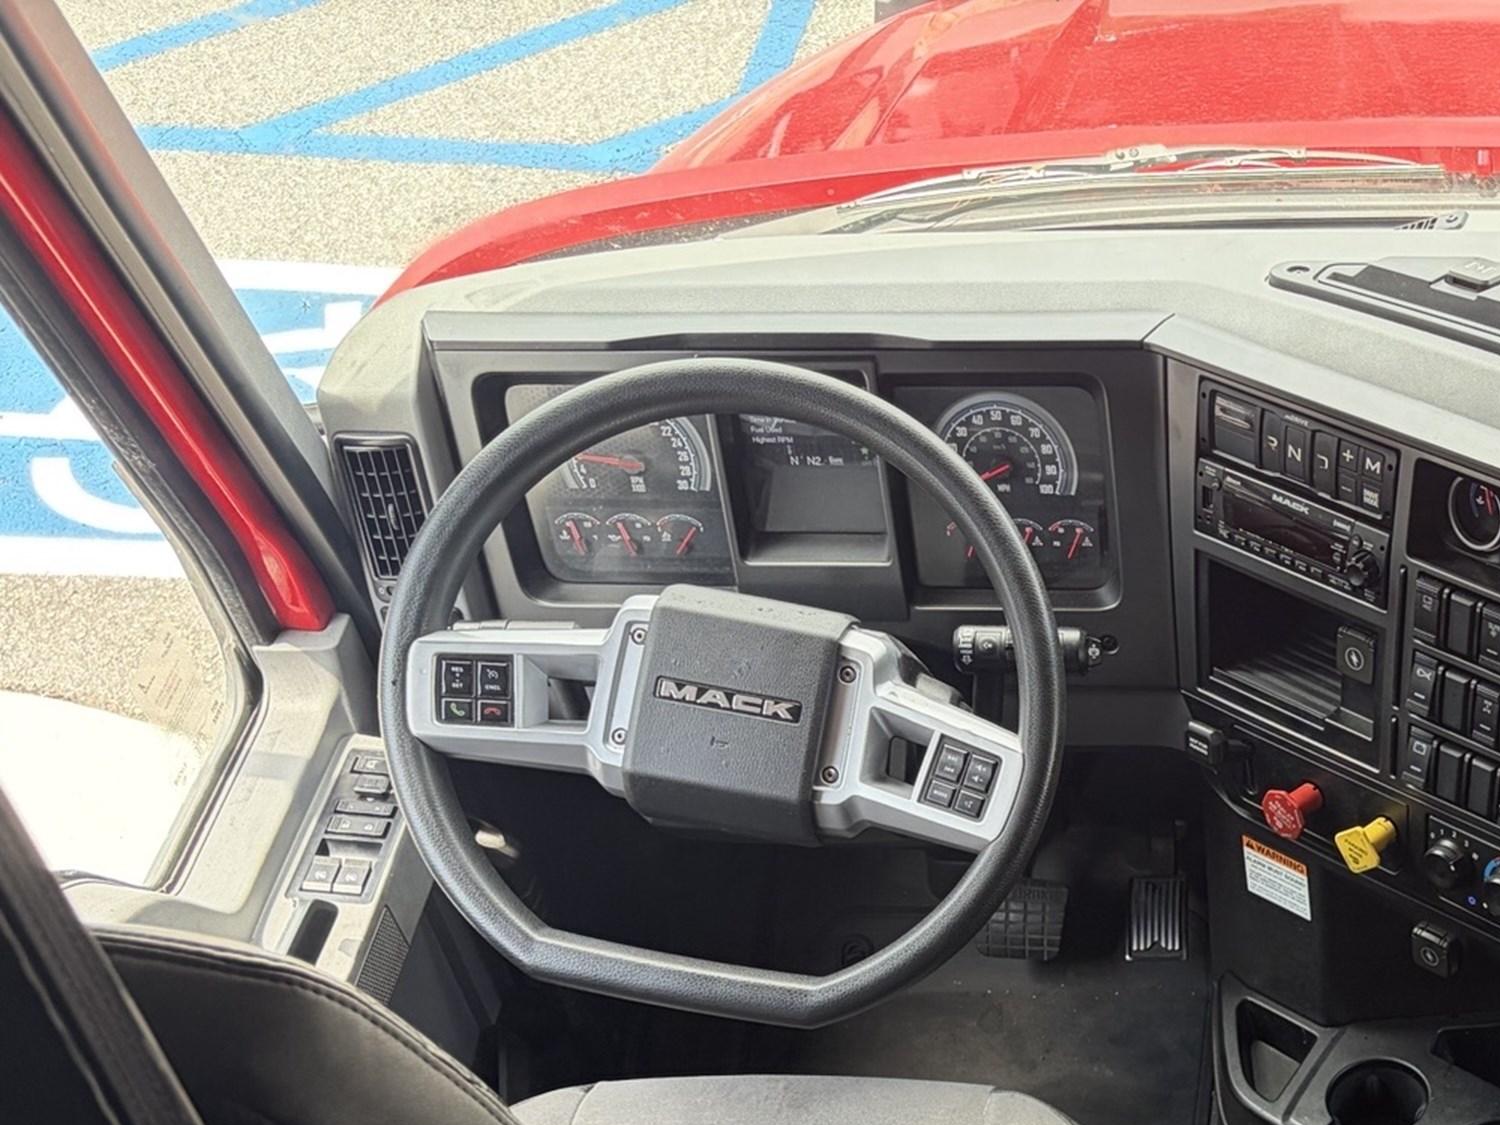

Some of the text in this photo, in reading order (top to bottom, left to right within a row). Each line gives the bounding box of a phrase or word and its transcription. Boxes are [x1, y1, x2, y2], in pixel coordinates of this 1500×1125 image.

[972, 414, 983, 425] 40
[990, 410, 1002, 420] 50
[1010, 415, 1022, 426] 60
[661, 426, 672, 437] 22
[956, 426, 968, 437] 30
[1029, 427, 1040, 438] 70
[671, 437, 682, 448] 24
[1041, 444, 1052, 454] 80
[1288, 444, 1302, 462] N
[1046, 465, 1056, 476] 90
[1365, 457, 1381, 474] M
[676, 480, 689, 490] 30
[1040, 484, 1054, 494] 100
[1272, 493, 1310, 515] MACK
[660, 679, 794, 720] MACK
[1255, 844, 1305, 874] WARNING
